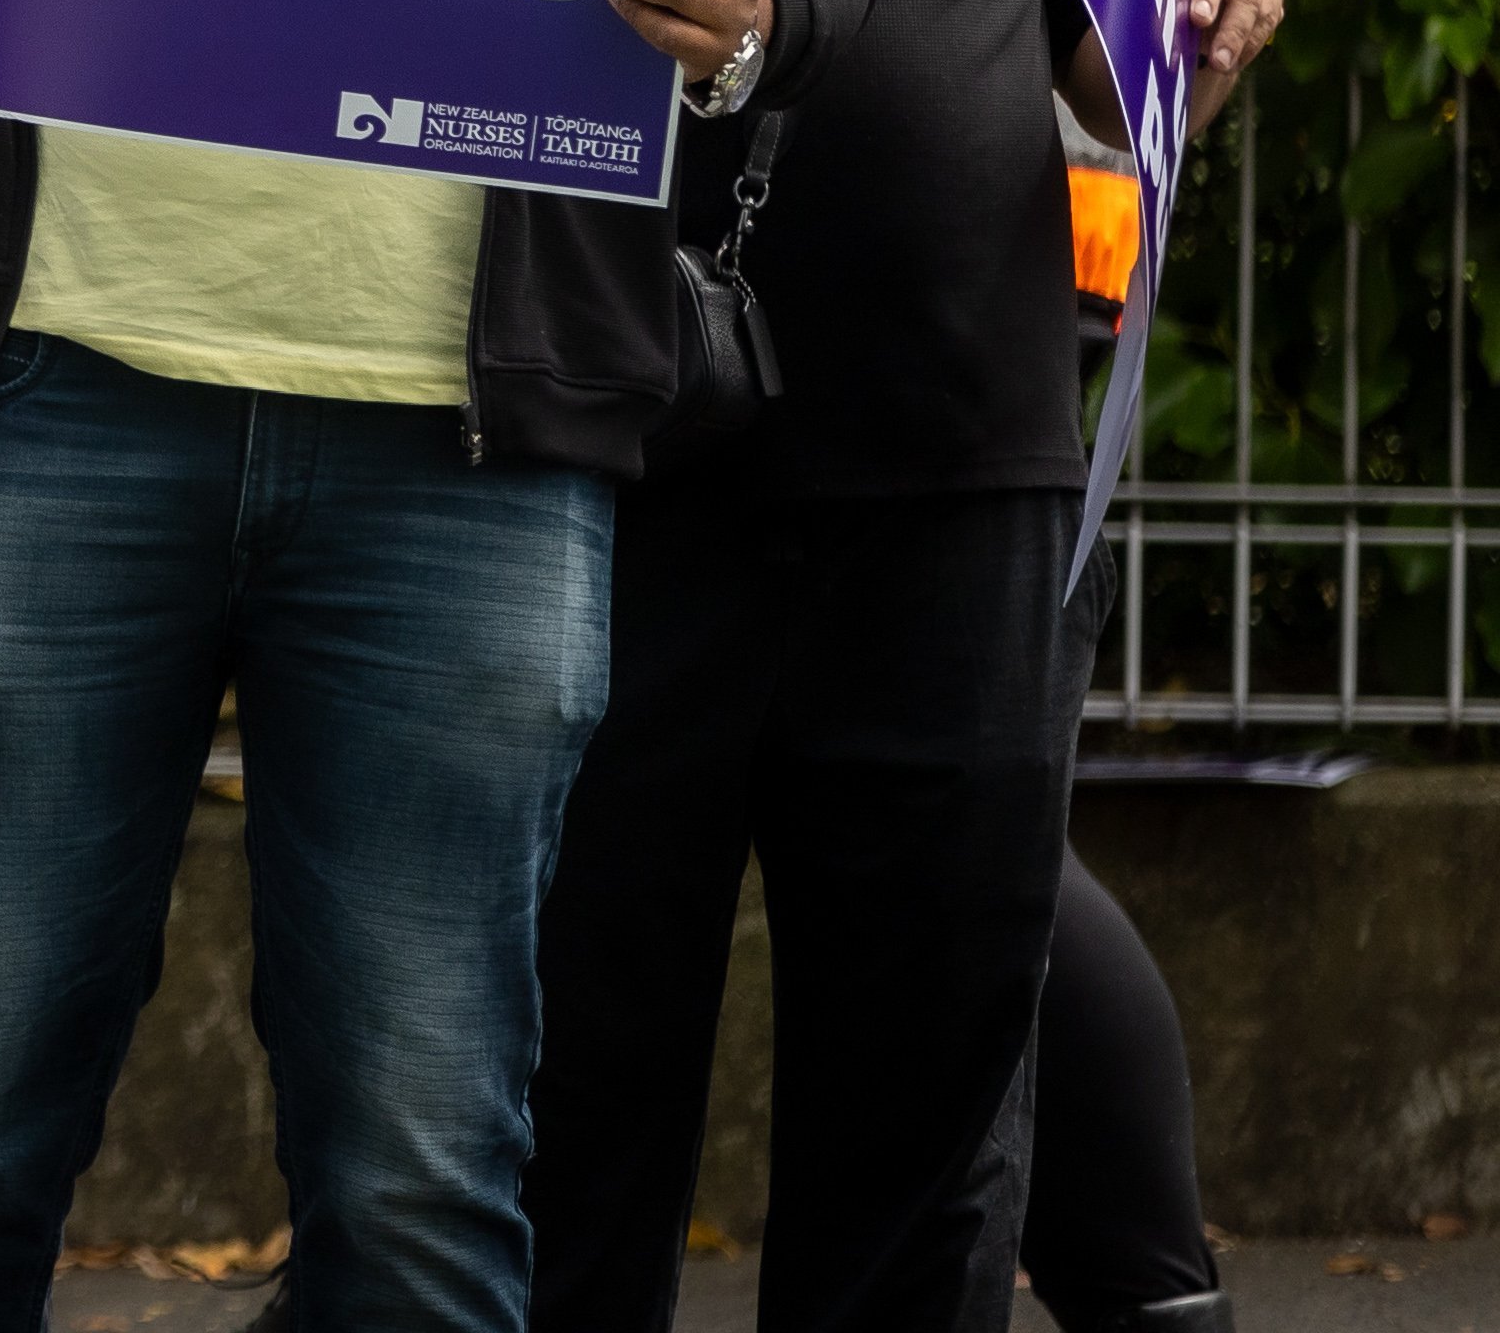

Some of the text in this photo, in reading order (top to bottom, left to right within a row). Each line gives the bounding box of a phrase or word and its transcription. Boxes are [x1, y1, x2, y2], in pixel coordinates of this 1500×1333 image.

[428, 102, 527, 126] NEW ZEALAND
[425, 117, 525, 146] NURSES
[545, 115, 643, 143] TŌPŪTANGA
[424, 138, 523, 160] ORGANISATION
[542, 133, 642, 164] TAPUHI
[579, 159, 587, 168] O
[588, 161, 639, 176] AOTEAROA
